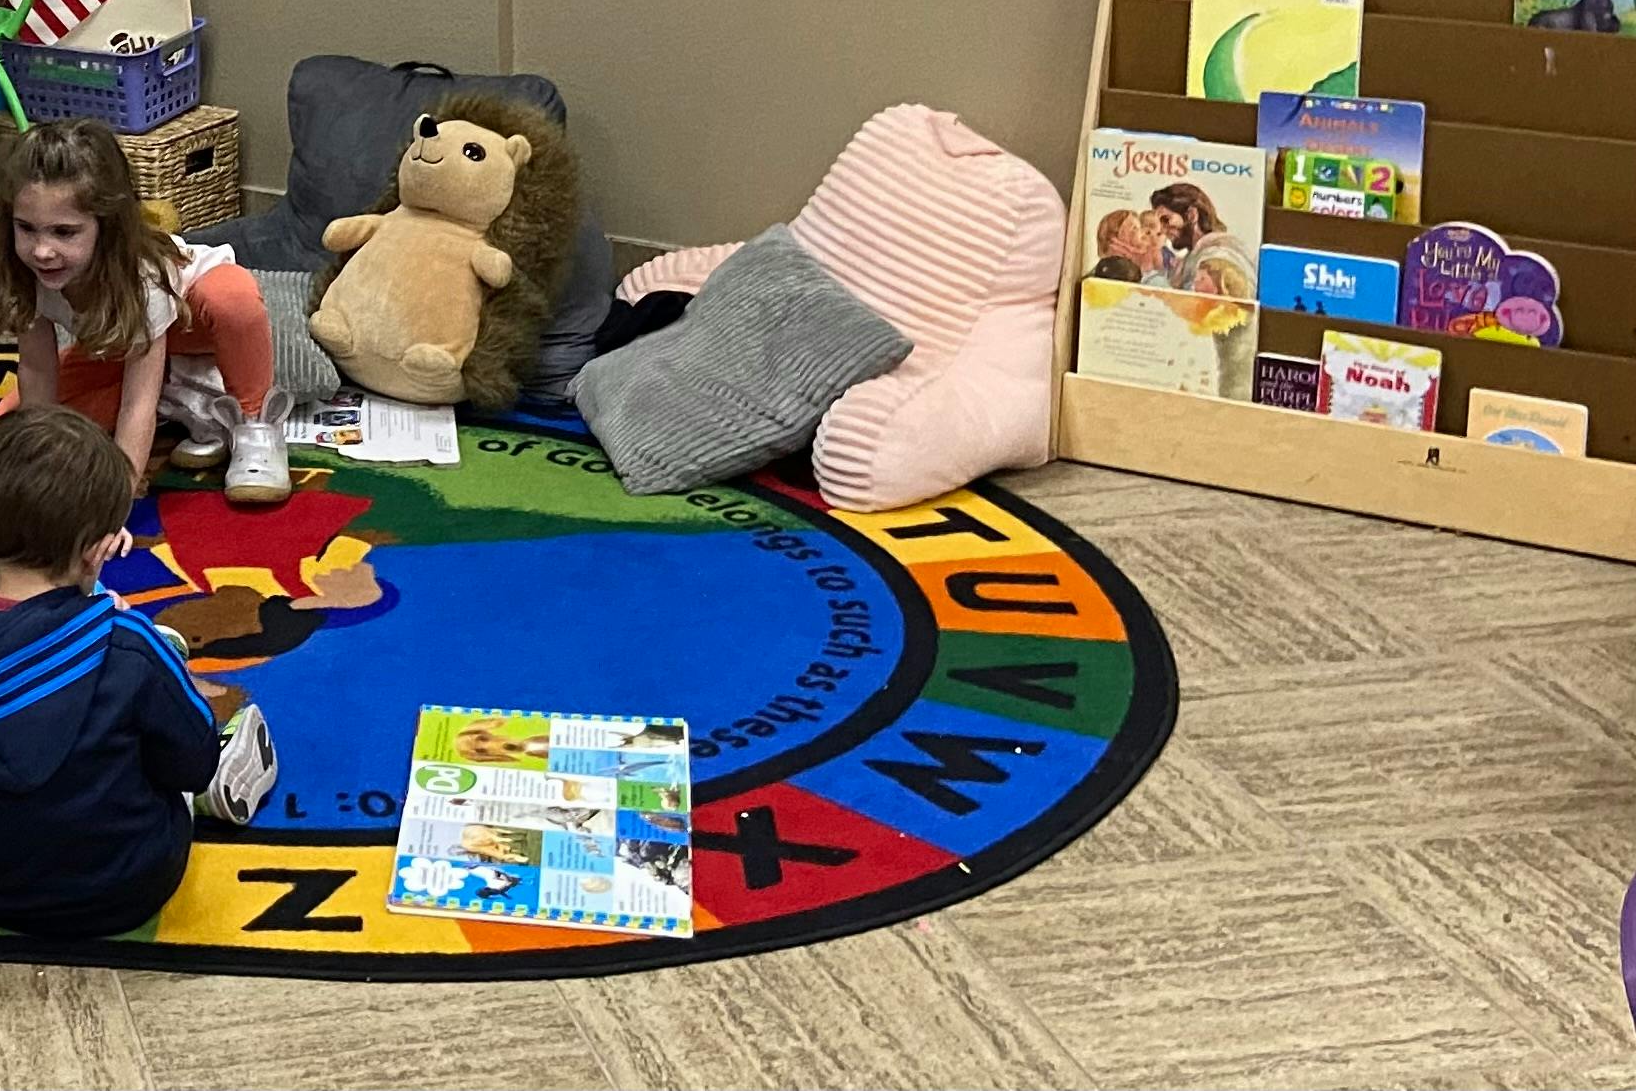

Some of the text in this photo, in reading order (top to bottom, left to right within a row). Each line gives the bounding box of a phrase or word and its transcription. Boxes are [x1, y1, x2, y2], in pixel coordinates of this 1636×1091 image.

[1092, 141, 1254, 179] MY Jesus BOOK
[1291, 155, 1308, 183] 1
[1312, 190, 1363, 206] numbers
[1369, 166, 1391, 193] 2
[1345, 367, 1411, 393] Noah
[478, 440, 613, 473] of Go
[686, 493, 821, 560] elongs
[884, 506, 1010, 544] T
[807, 565, 855, 591] to
[944, 570, 1080, 615] U
[822, 599, 883, 658] such
[796, 661, 850, 691] as
[945, 661, 1079, 711] V
[864, 728, 1048, 816] W
[693, 805, 860, 891] X
